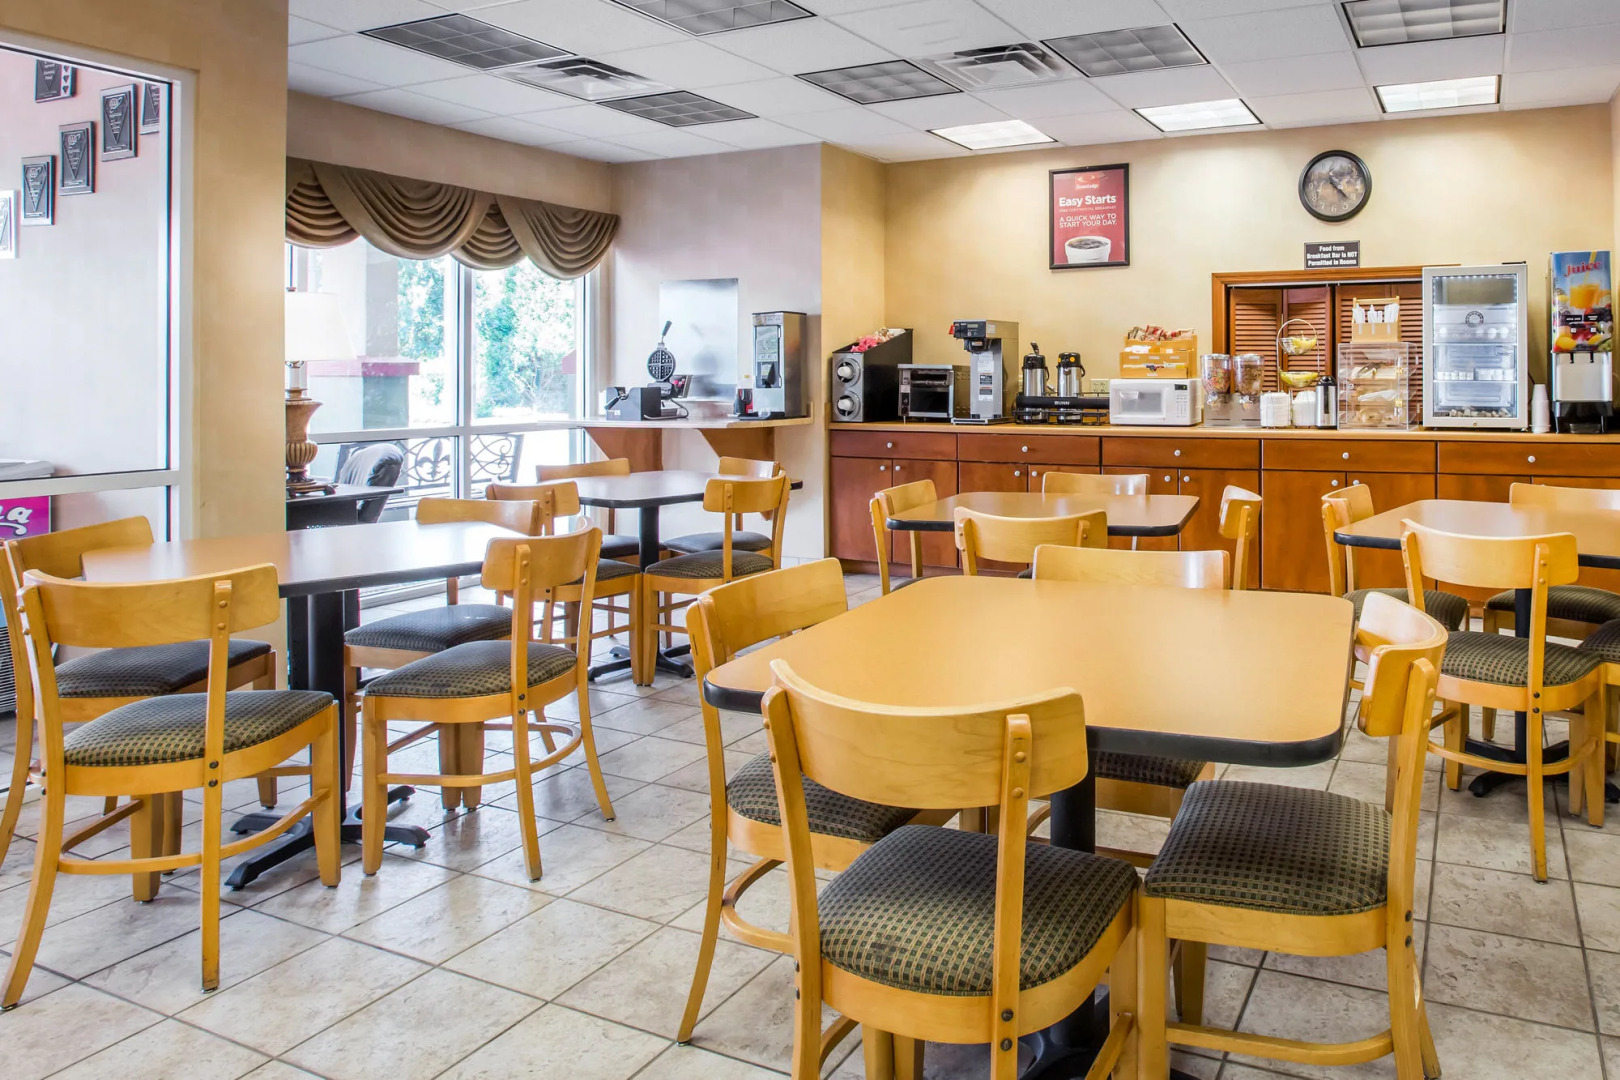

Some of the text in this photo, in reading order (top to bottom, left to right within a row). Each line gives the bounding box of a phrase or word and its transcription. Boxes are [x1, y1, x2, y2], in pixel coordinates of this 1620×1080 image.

[1059, 194, 1117, 207] Easy Starts
[1065, 214, 1088, 222] QUICK
[1564, 261, 1601, 277] Juice
